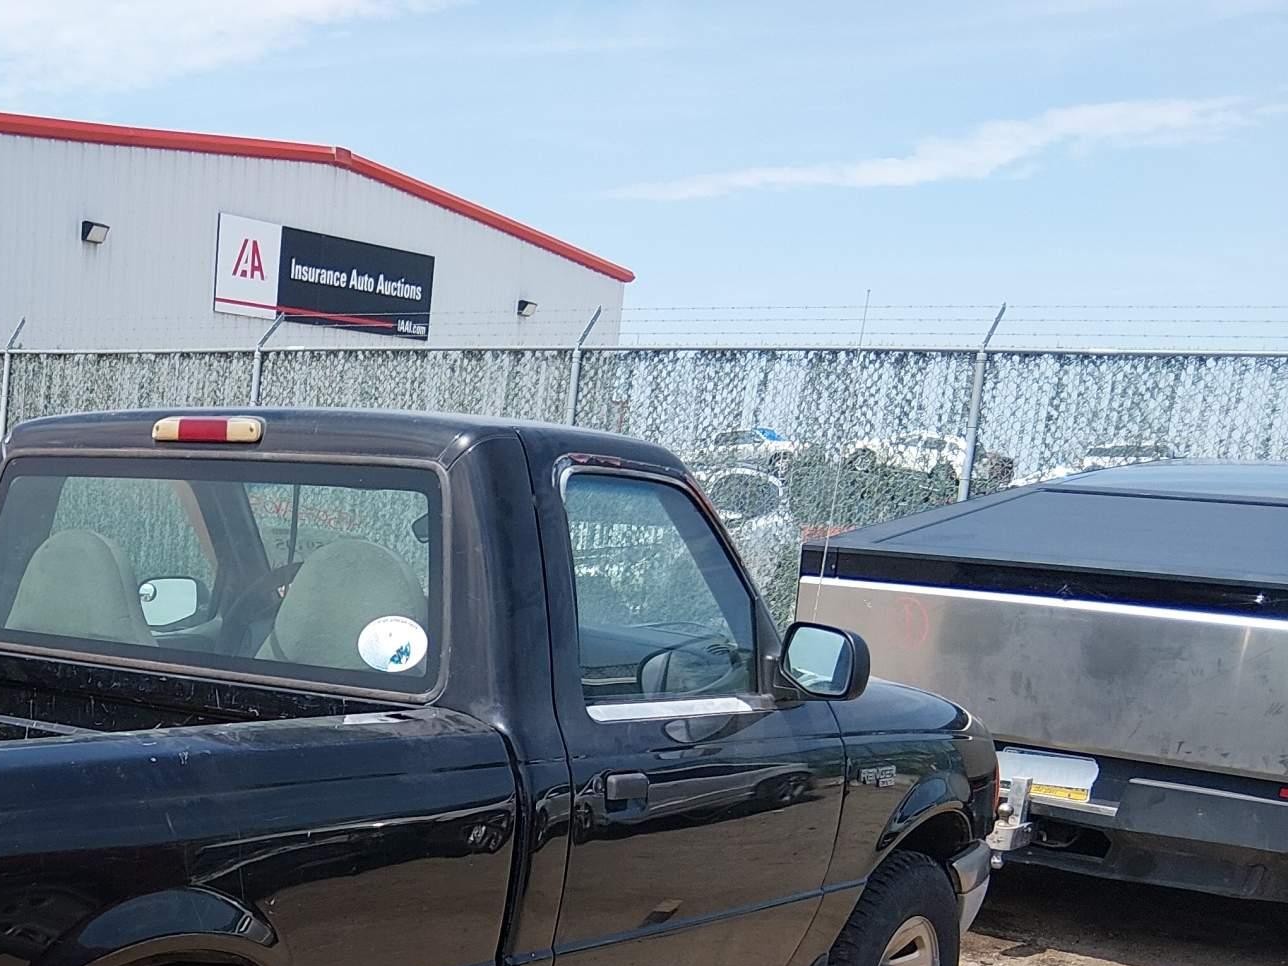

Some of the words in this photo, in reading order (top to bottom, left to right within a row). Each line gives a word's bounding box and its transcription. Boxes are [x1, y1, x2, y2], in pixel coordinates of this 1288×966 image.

[290, 258, 347, 288] Insurance
[349, 269, 375, 293] Auto
[376, 274, 423, 301] Auctions
[397, 319, 427, 335] IAAI.com
